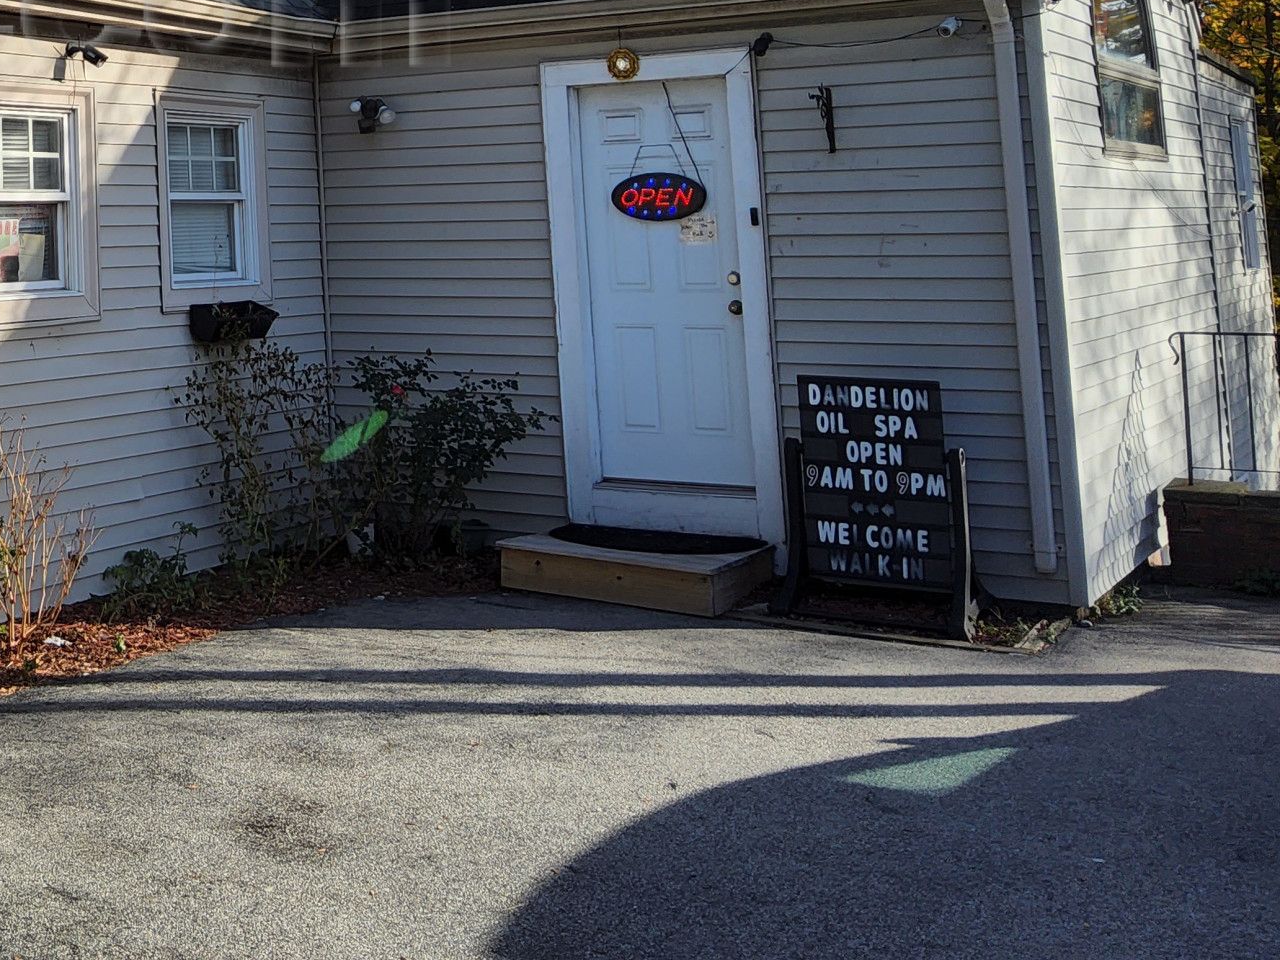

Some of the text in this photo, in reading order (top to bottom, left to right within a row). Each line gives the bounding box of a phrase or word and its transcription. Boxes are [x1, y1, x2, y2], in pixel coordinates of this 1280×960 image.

[621, 188, 693, 207] OPEN
[808, 383, 928, 411] DANDELION
[816, 411, 918, 439] OIL SPA
[846, 441, 902, 466] OPEN
[807, 465, 946, 497] 9AM TO 9PM
